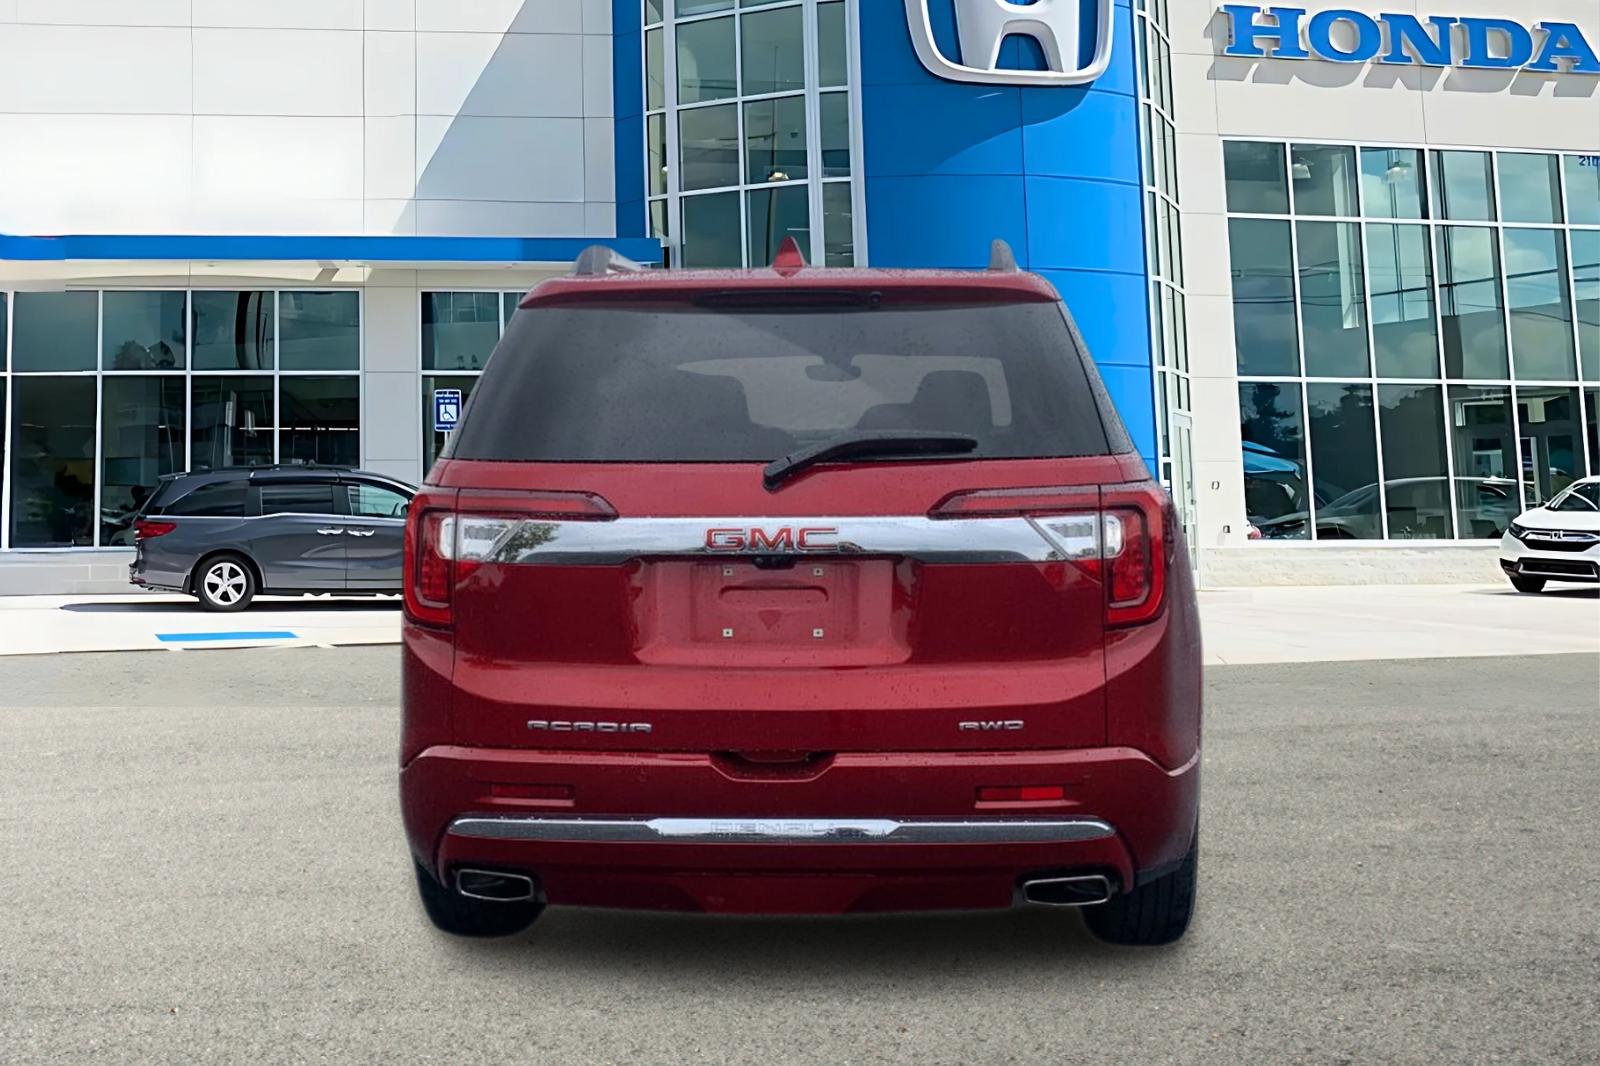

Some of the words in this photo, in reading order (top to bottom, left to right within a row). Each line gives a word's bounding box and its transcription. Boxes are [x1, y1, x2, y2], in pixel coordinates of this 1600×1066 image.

[1221, 5, 1600, 74] HONDA
[705, 527, 838, 552] GMC
[527, 720, 652, 733] ACADIA
[958, 720, 1024, 731] AWD
